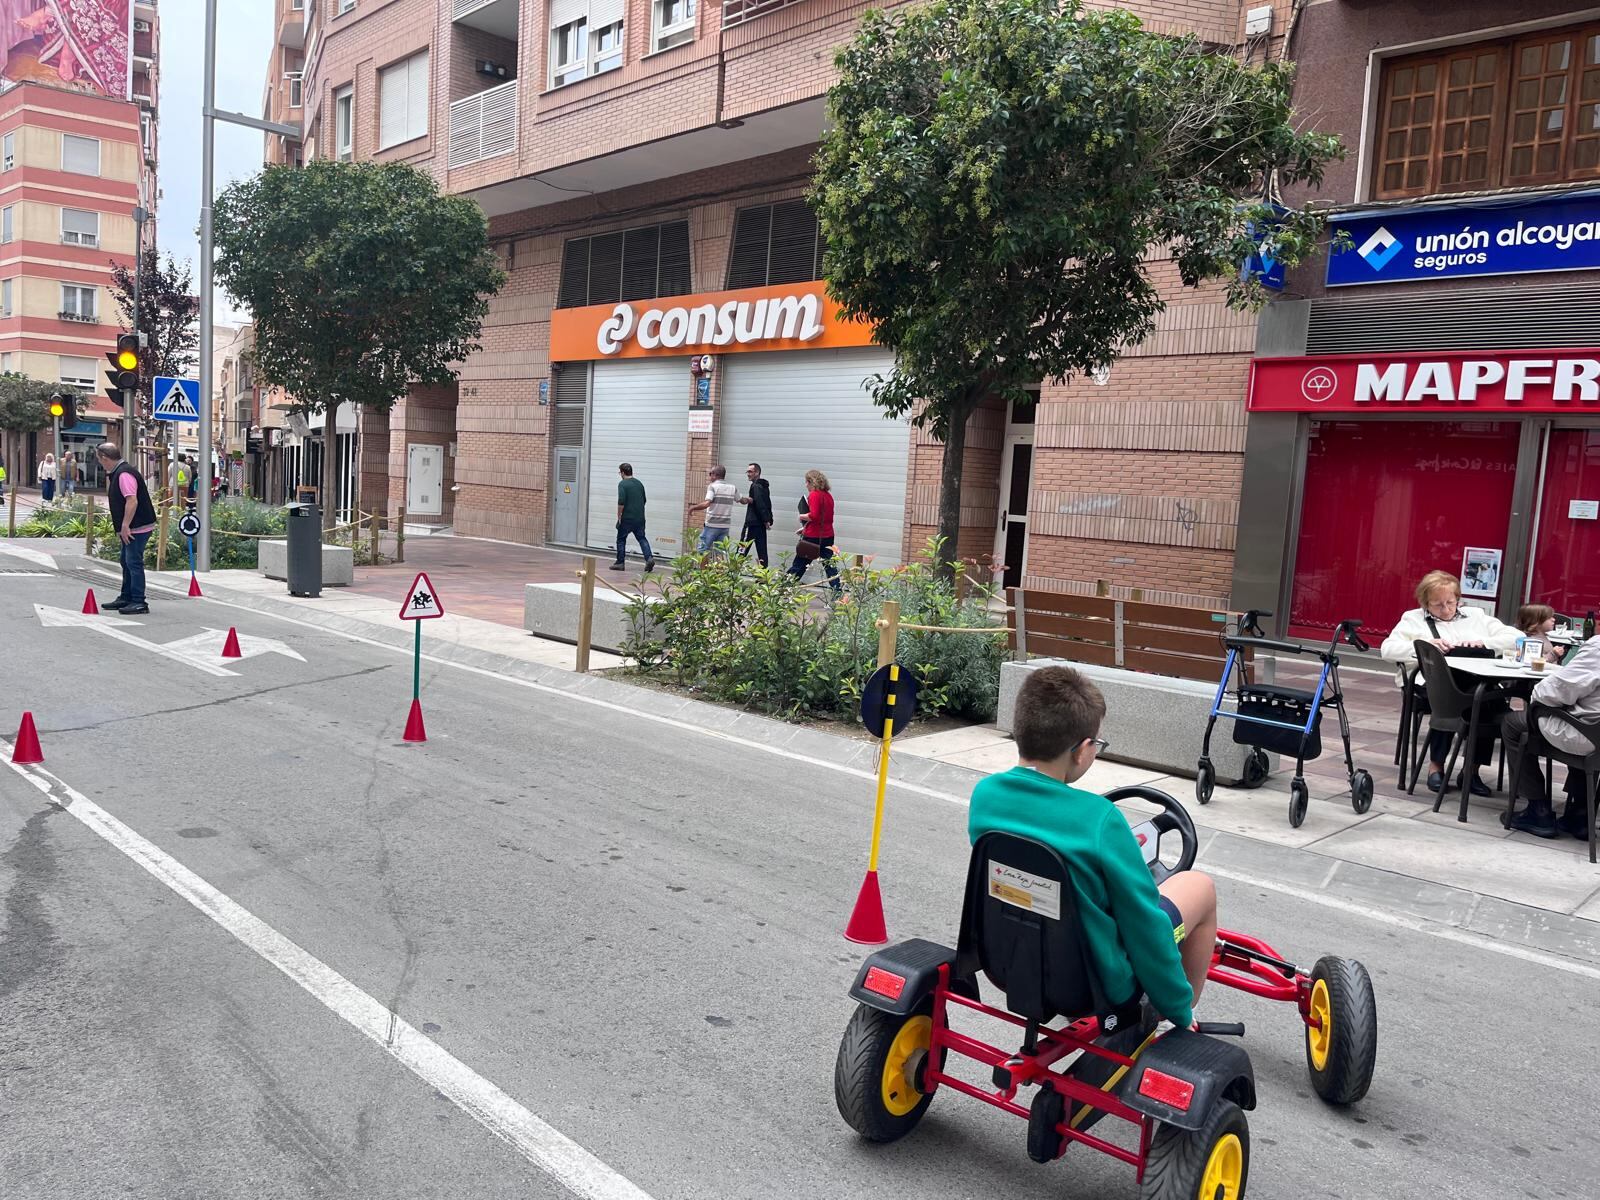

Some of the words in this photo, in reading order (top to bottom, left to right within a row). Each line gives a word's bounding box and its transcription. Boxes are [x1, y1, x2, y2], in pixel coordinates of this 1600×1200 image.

[1415, 226, 1490, 253] unión
[1496, 221, 1600, 250] alcoya
[1413, 252, 1487, 271] seguros
[637, 293, 822, 349] consum
